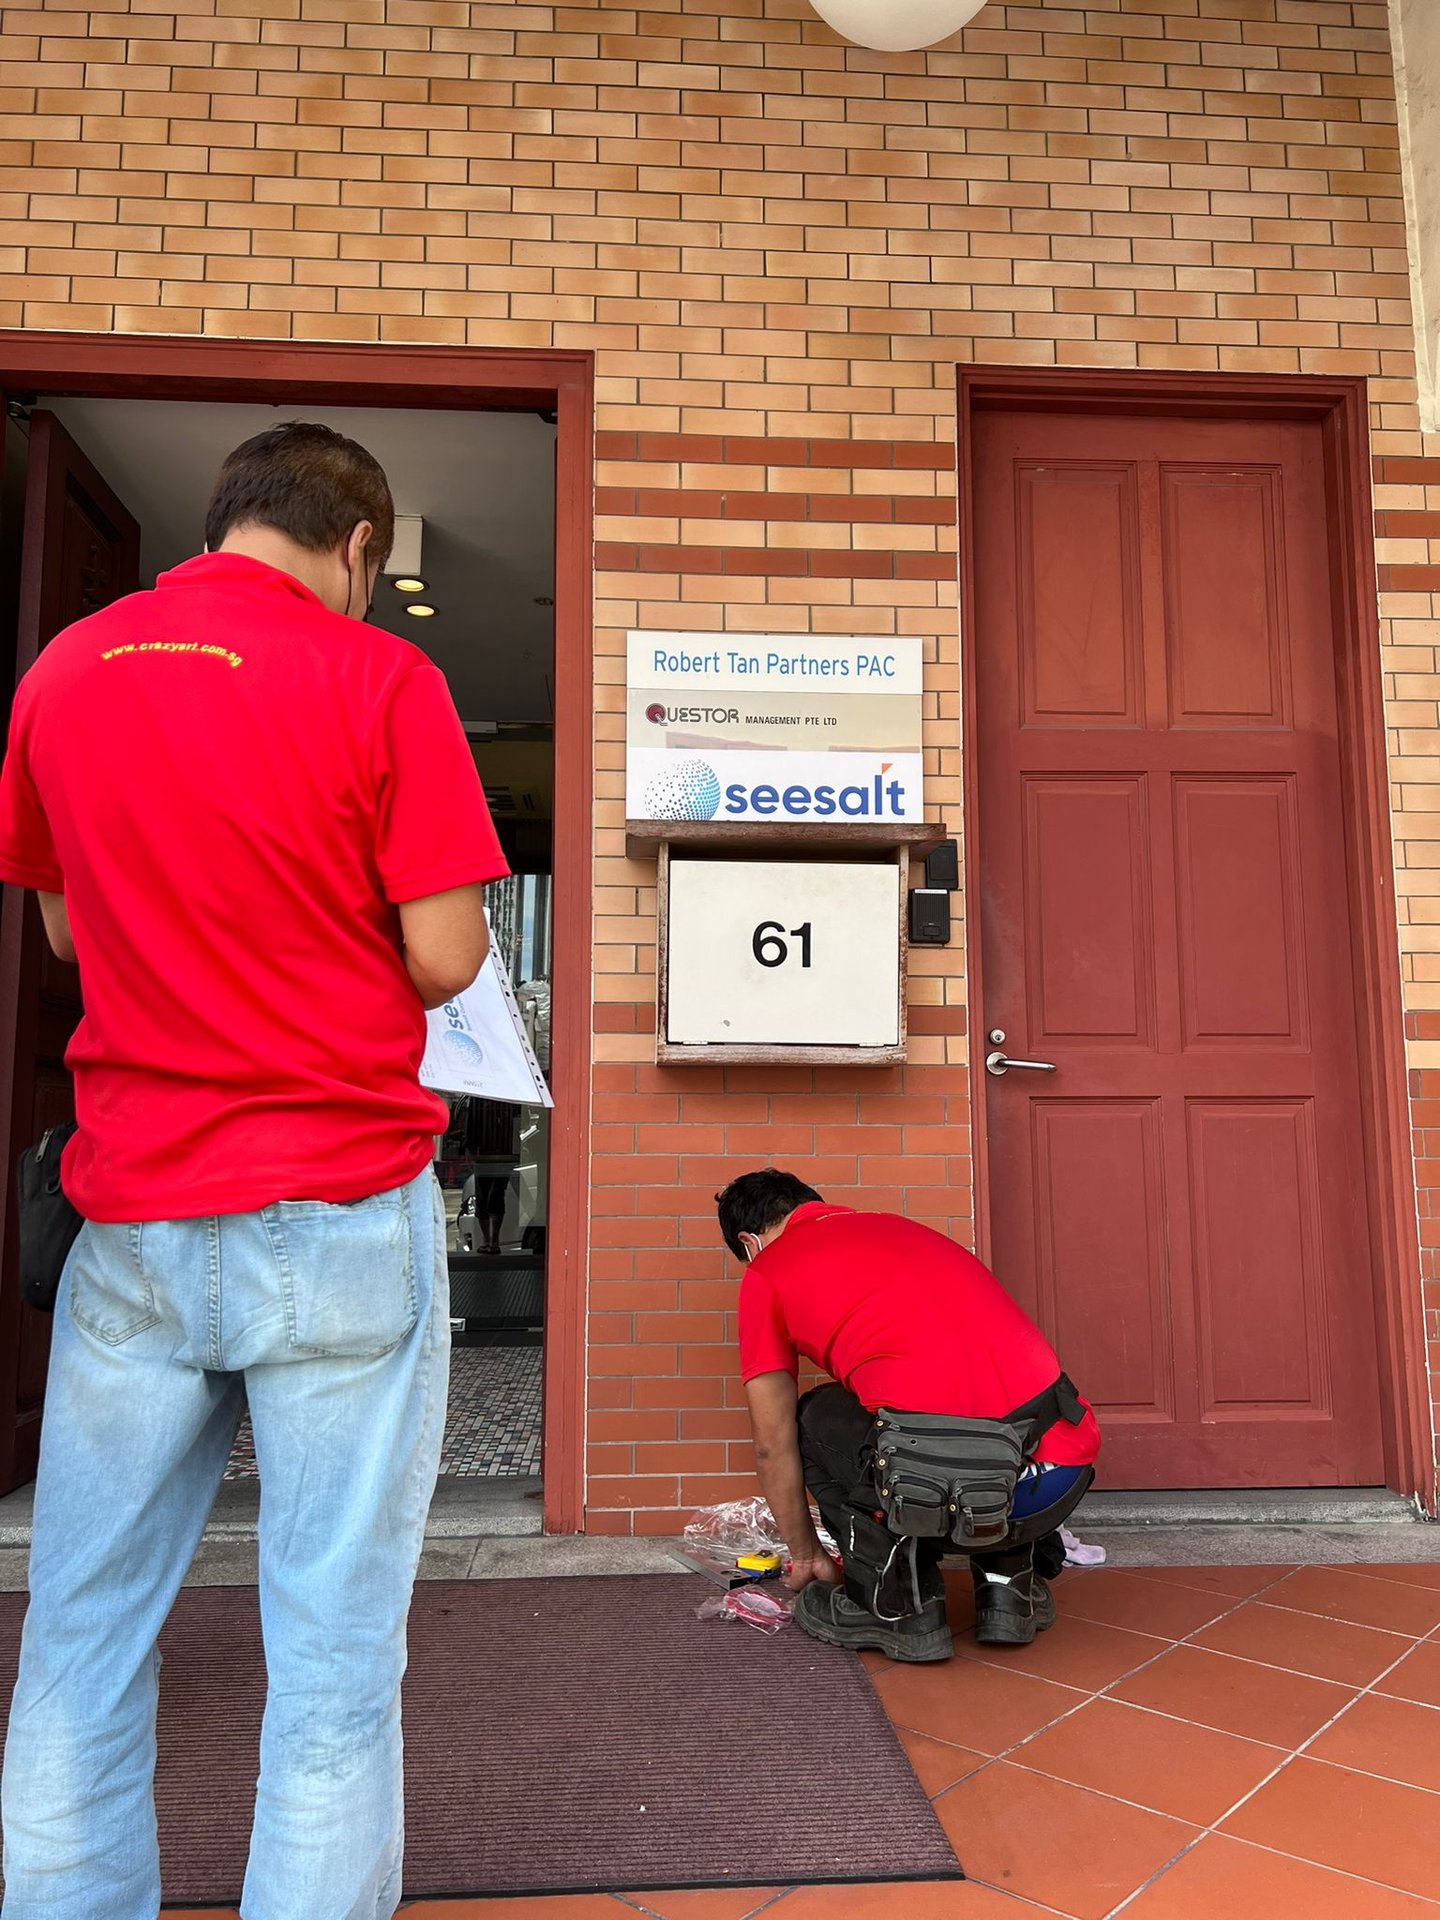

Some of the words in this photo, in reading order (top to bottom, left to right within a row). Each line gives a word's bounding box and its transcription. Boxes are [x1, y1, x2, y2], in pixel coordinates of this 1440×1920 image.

[101, 642, 243, 667] www.crazyart.com.sg
[653, 650, 720, 673] Robert
[727, 652, 760, 674] Tan
[766, 653, 850, 676] Partners
[856, 655, 896, 677] PAC
[645, 702, 739, 727] QUESTOR
[745, 715, 801, 726] MANAGEMENT
[804, 716, 820, 726] PTE
[823, 717, 838, 726] LTD
[725, 763, 905, 815] seesalt
[752, 920, 811, 968] 61
